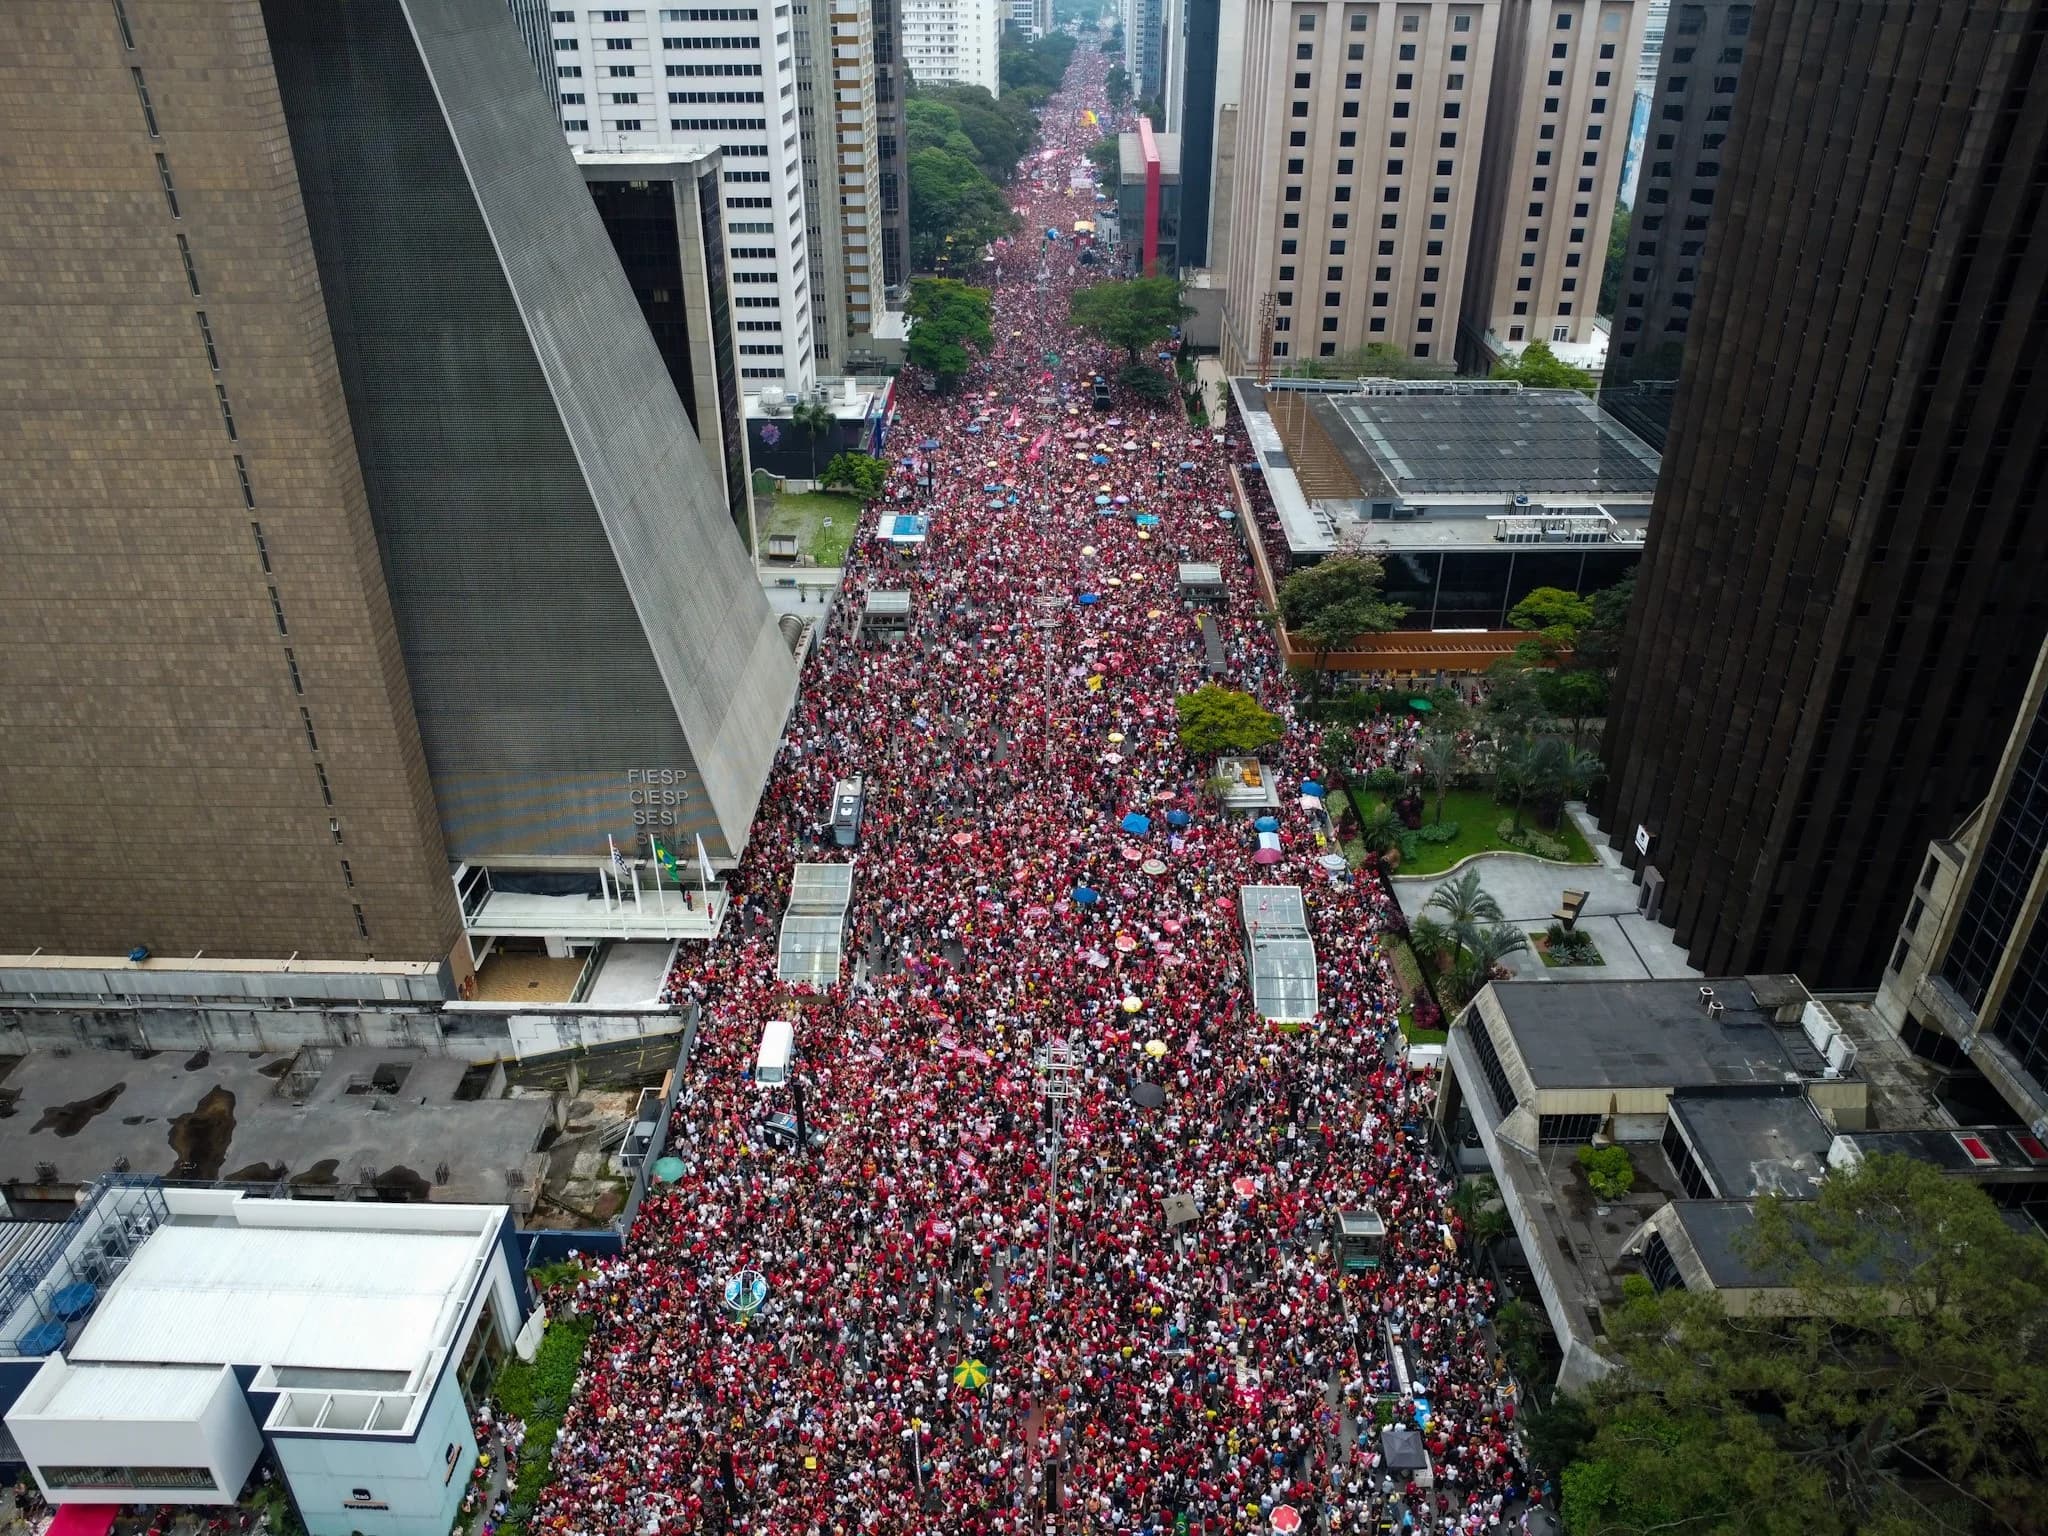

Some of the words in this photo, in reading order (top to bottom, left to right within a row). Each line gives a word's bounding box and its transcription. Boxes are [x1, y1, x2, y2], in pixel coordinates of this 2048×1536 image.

[628, 769, 687, 784] FIESP
[629, 790, 689, 805] CIESP
[633, 810, 678, 825] SESI
